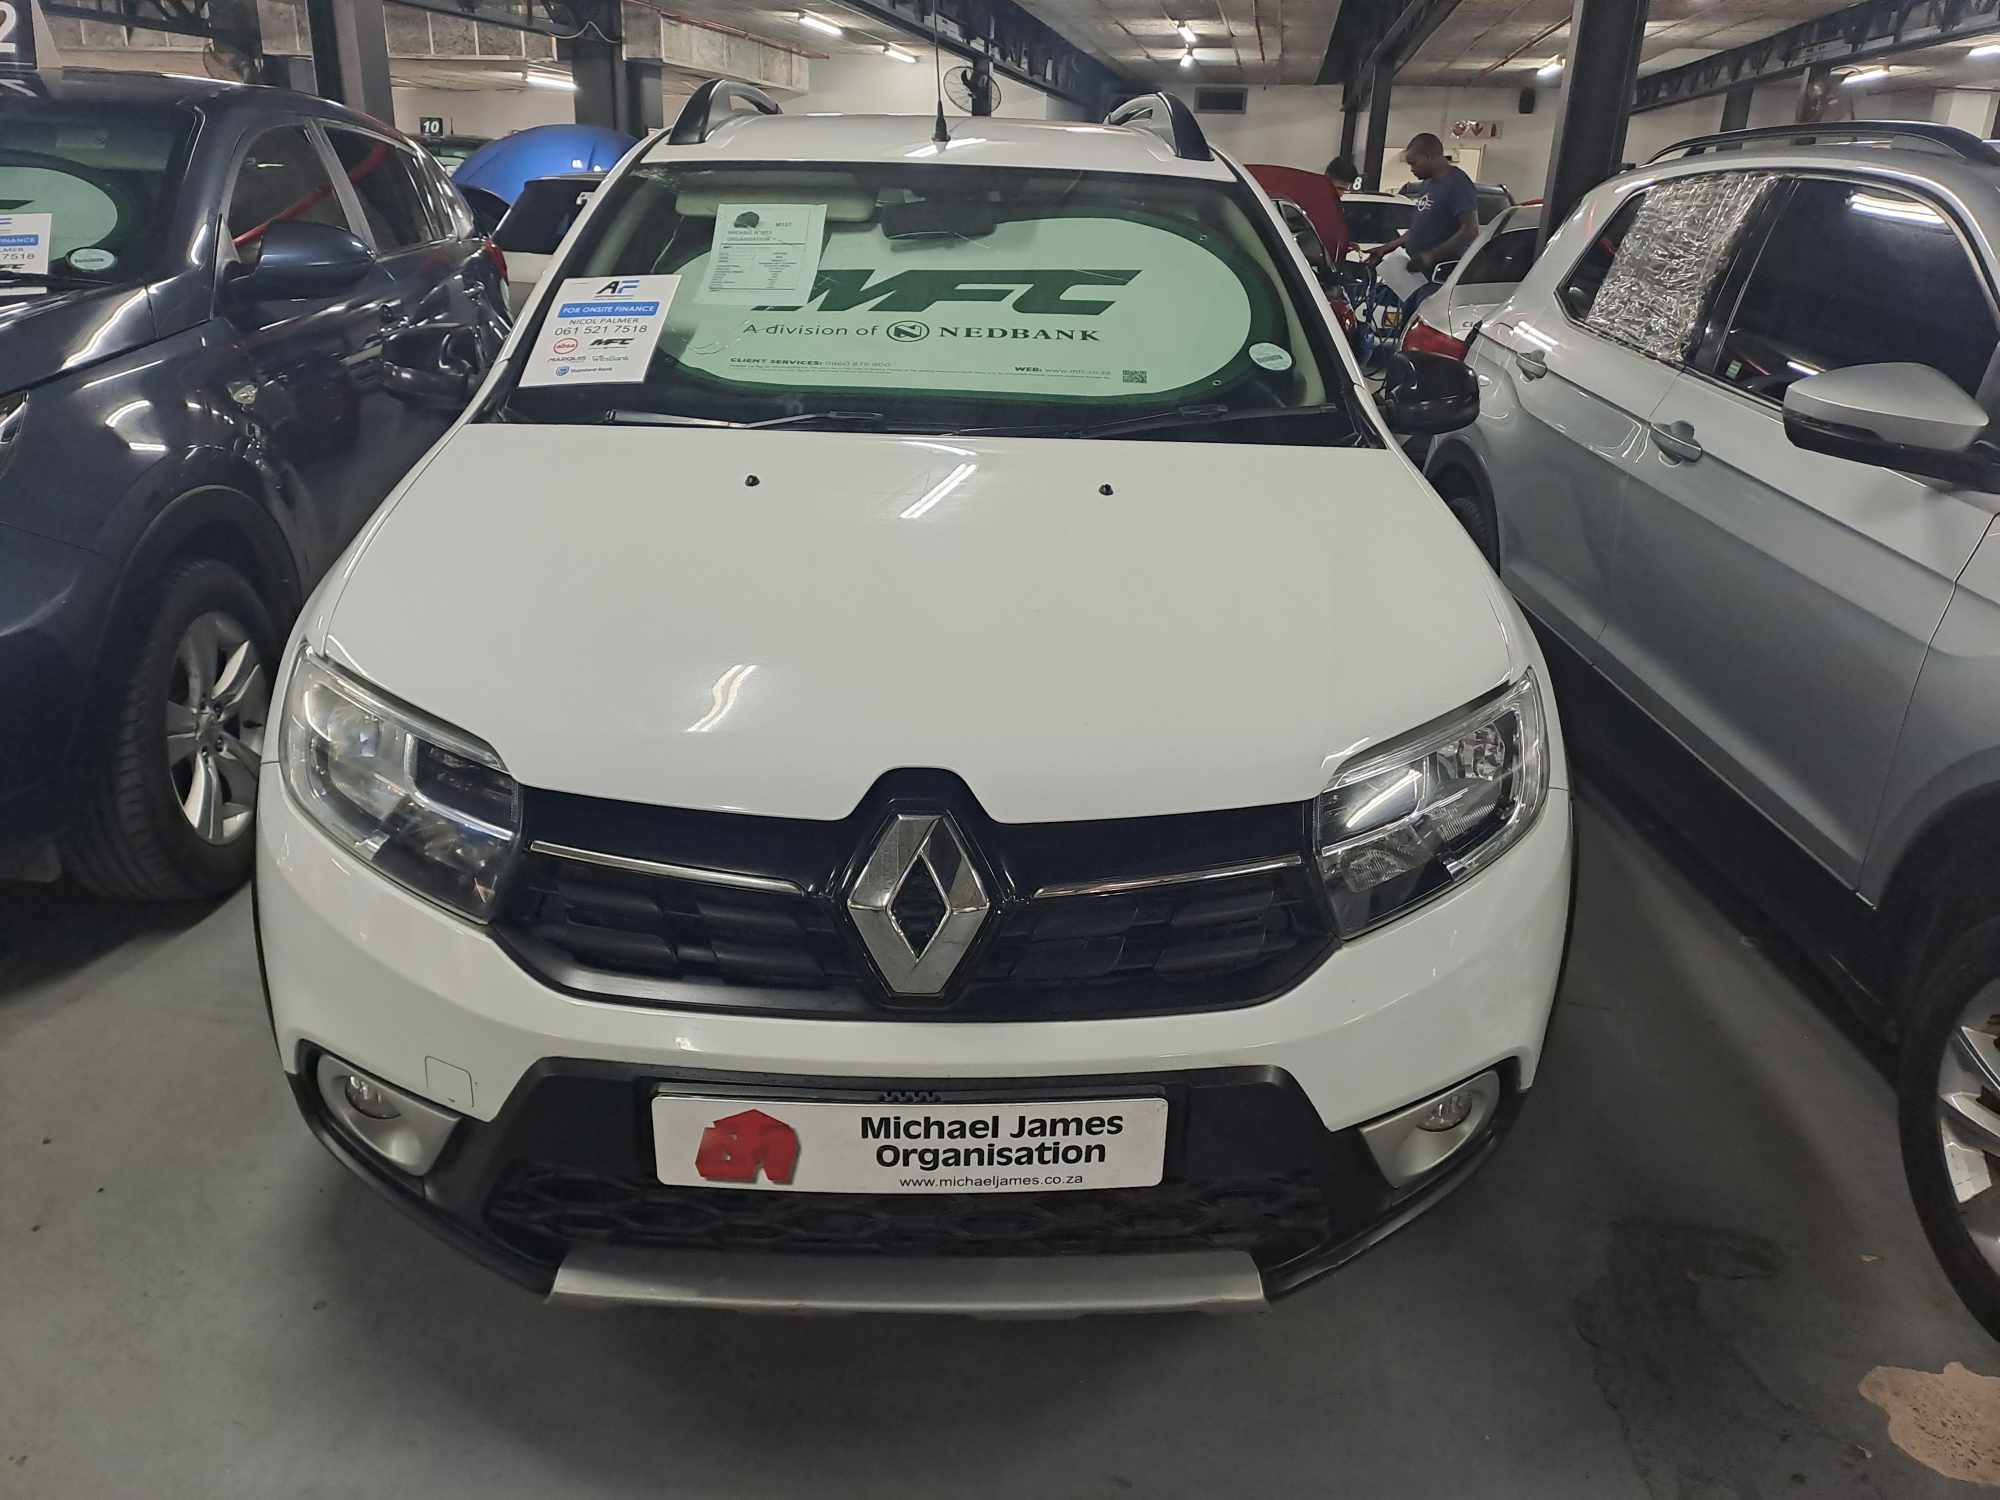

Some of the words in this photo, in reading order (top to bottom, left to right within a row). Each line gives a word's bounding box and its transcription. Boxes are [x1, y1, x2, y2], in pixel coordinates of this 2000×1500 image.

[424, 121, 440, 133] 10
[596, 280, 640, 295] AF
[751, 269, 1142, 314] MFC
[562, 306, 581, 314] FOR
[583, 305, 613, 313] ONSITE
[614, 304, 655, 312] FINANCE
[600, 317, 639, 325] PALMER
[554, 327, 579, 336] 061
[584, 325, 608, 335] 521
[615, 324, 648, 334] 7518
[743, 323, 758, 334] A
[765, 324, 848, 336] division
[856, 325, 880, 336] of
[940, 326, 1101, 342] NEDBANK
[861, 1115, 999, 1140] Michael
[1010, 1114, 1124, 1138] James
[876, 1141, 1106, 1171] Organisation
[900, 1174, 1083, 1188] www.michaeljames.co.za
